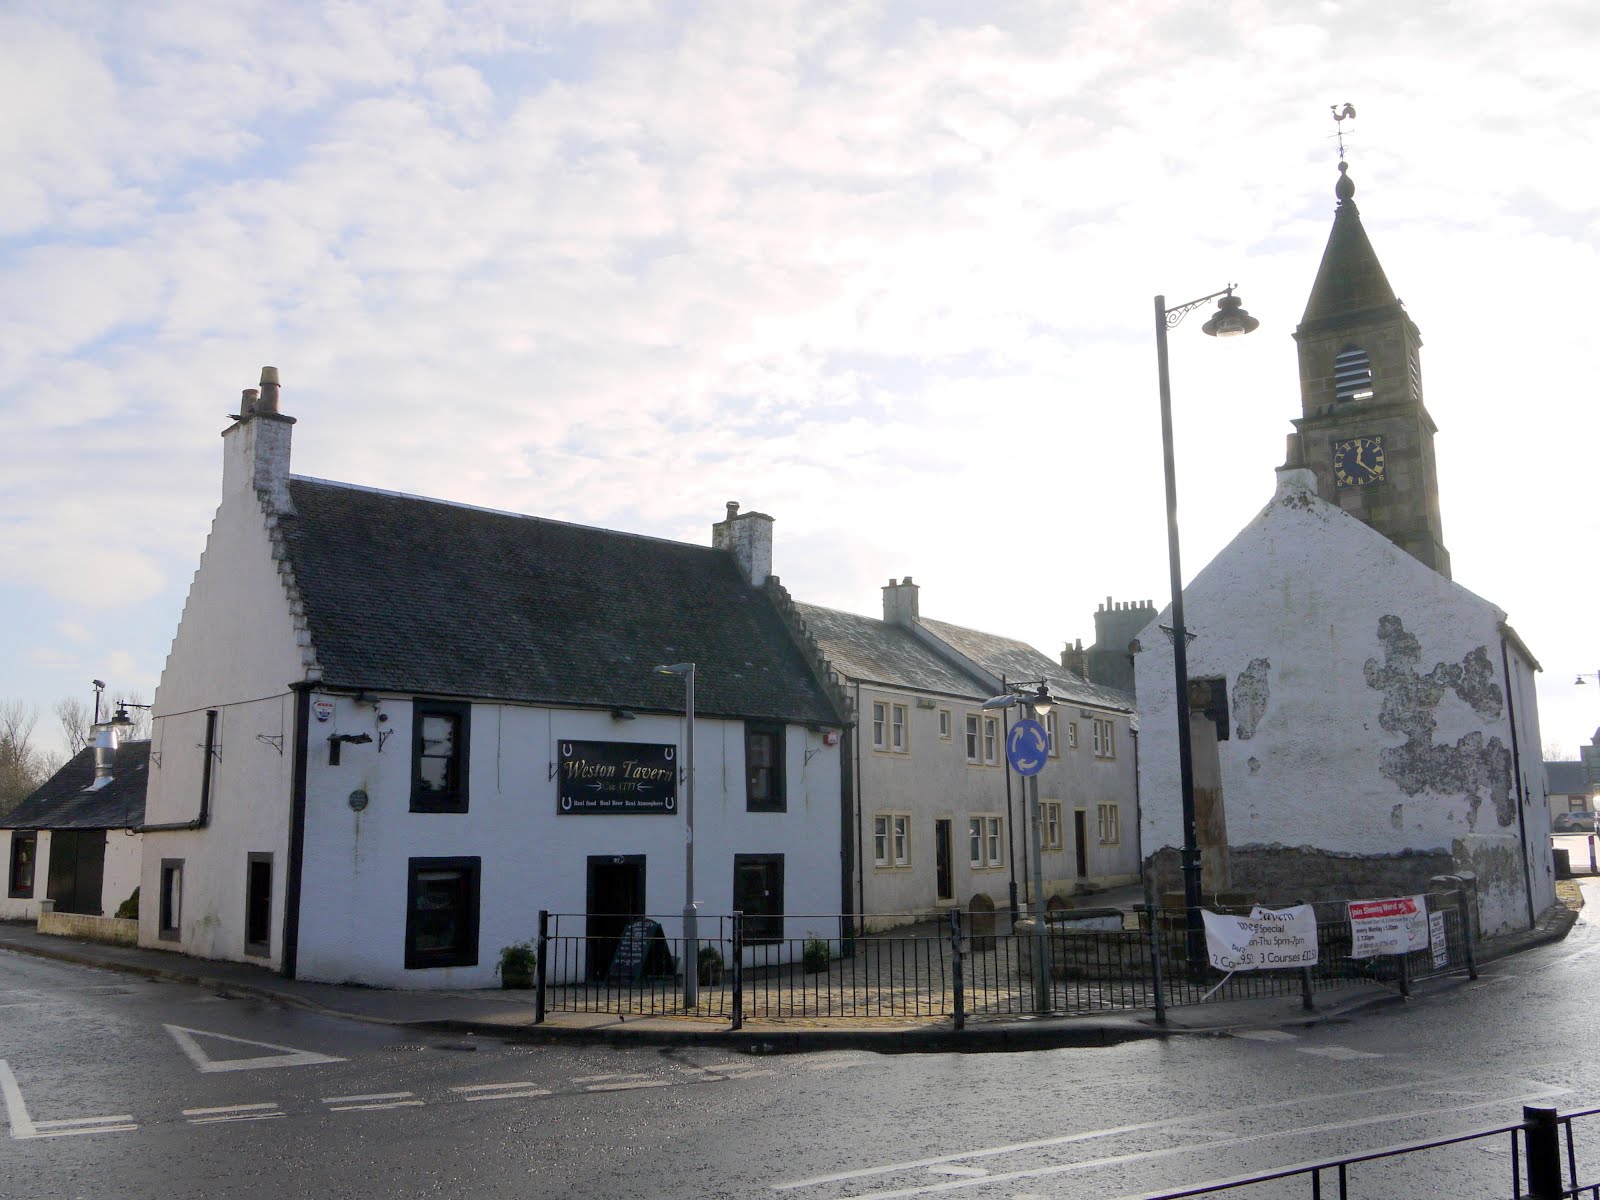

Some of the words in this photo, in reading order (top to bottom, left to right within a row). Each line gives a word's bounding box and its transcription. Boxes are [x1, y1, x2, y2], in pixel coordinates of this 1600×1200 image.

[564, 759, 616, 780] Weston
[622, 760, 673, 782] Tavern
[1259, 924, 1285, 936] Special
[1260, 952, 1266, 964] 3
[1267, 952, 1301, 963] Courses
